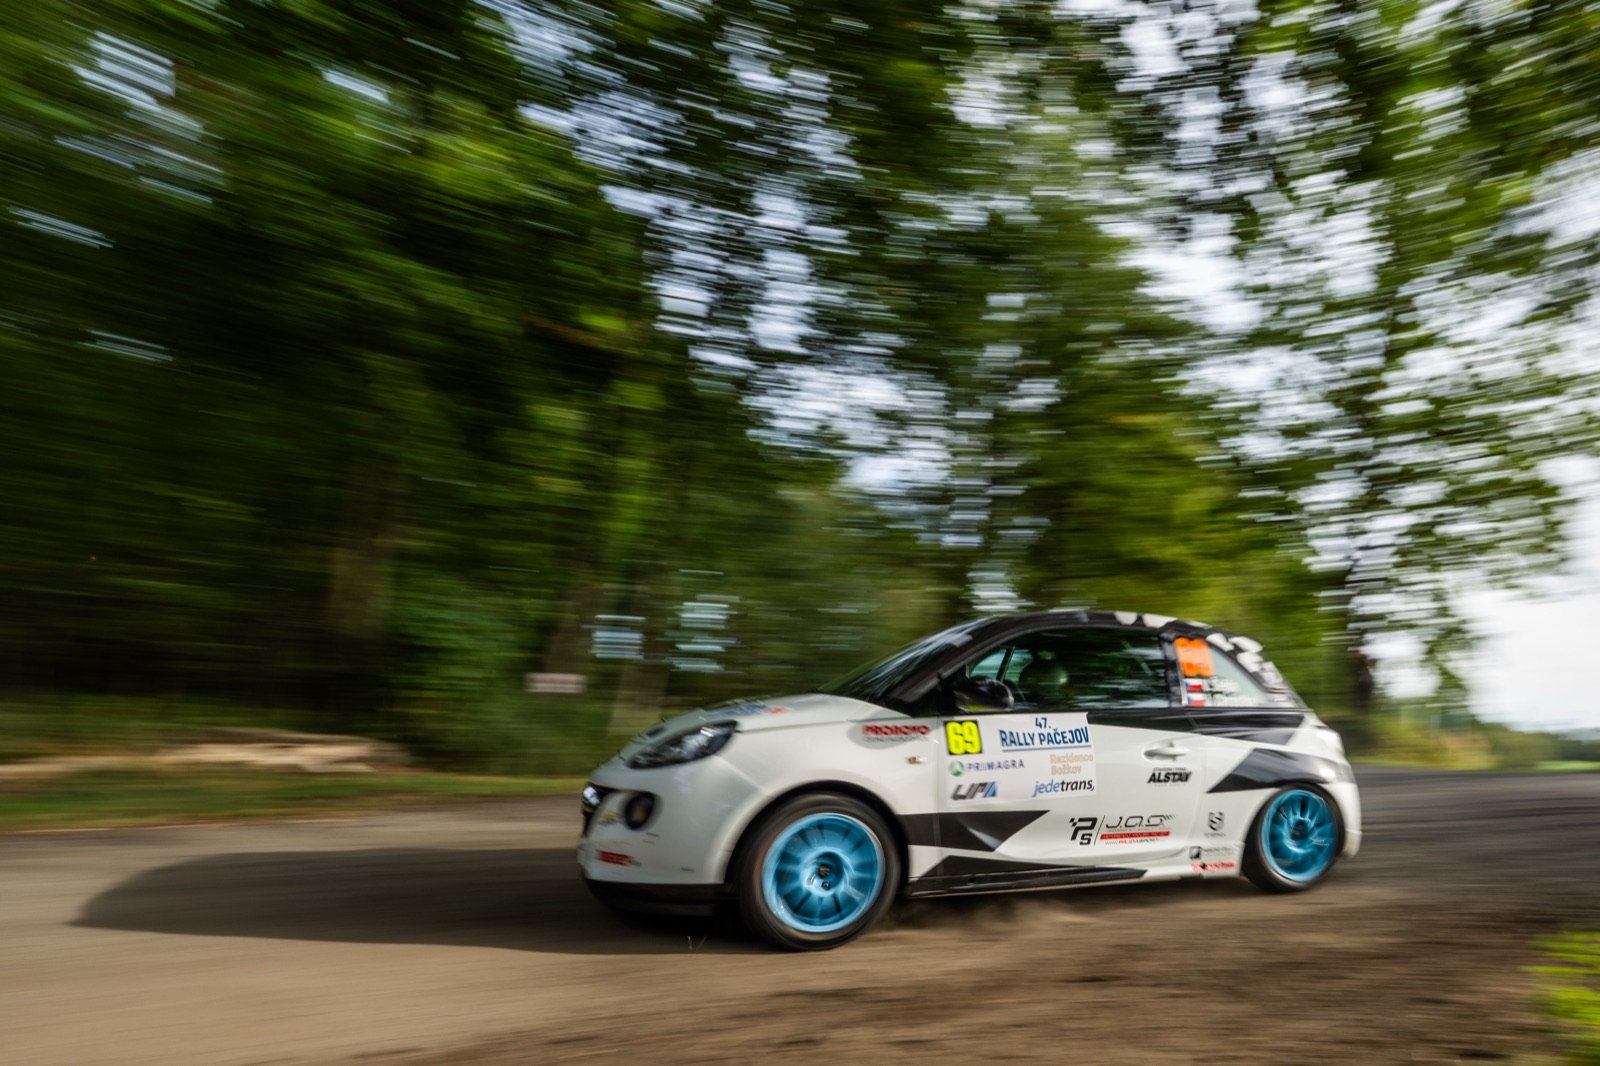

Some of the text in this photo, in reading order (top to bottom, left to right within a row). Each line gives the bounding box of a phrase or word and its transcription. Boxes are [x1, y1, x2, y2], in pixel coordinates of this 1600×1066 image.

[1035, 717, 1051, 729] 47.
[946, 720, 982, 754] 69
[999, 726, 1089, 747] RALLY PAČEJOV
[967, 760, 1025, 772] PRIMAGRA
